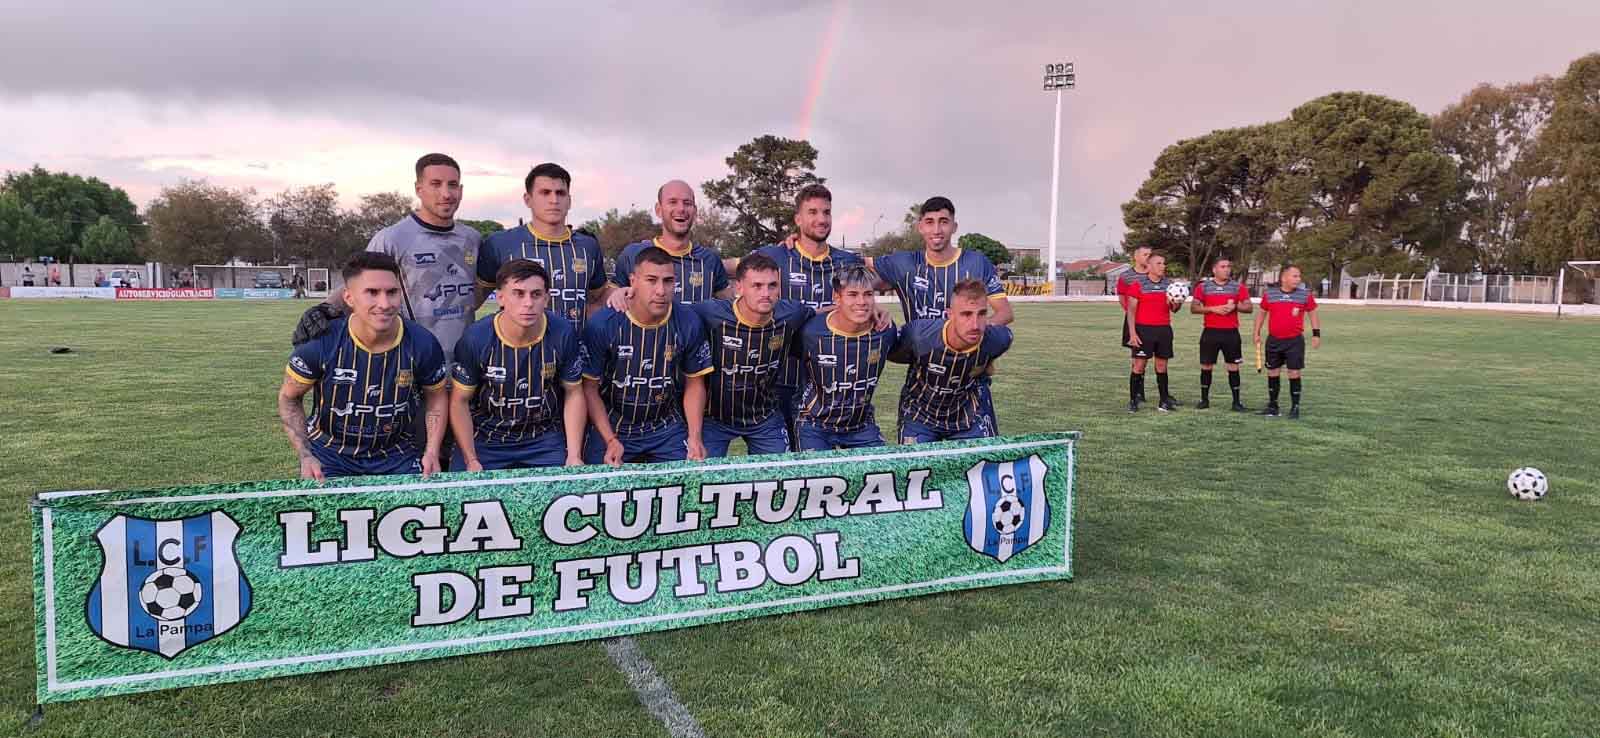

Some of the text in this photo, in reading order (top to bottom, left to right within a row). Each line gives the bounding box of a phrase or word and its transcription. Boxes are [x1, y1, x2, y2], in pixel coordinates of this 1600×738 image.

[279, 469, 944, 569] LIGA CULTURAL
[410, 532, 861, 627] DE FUTBOL
[135, 622, 213, 638] La Pampa
